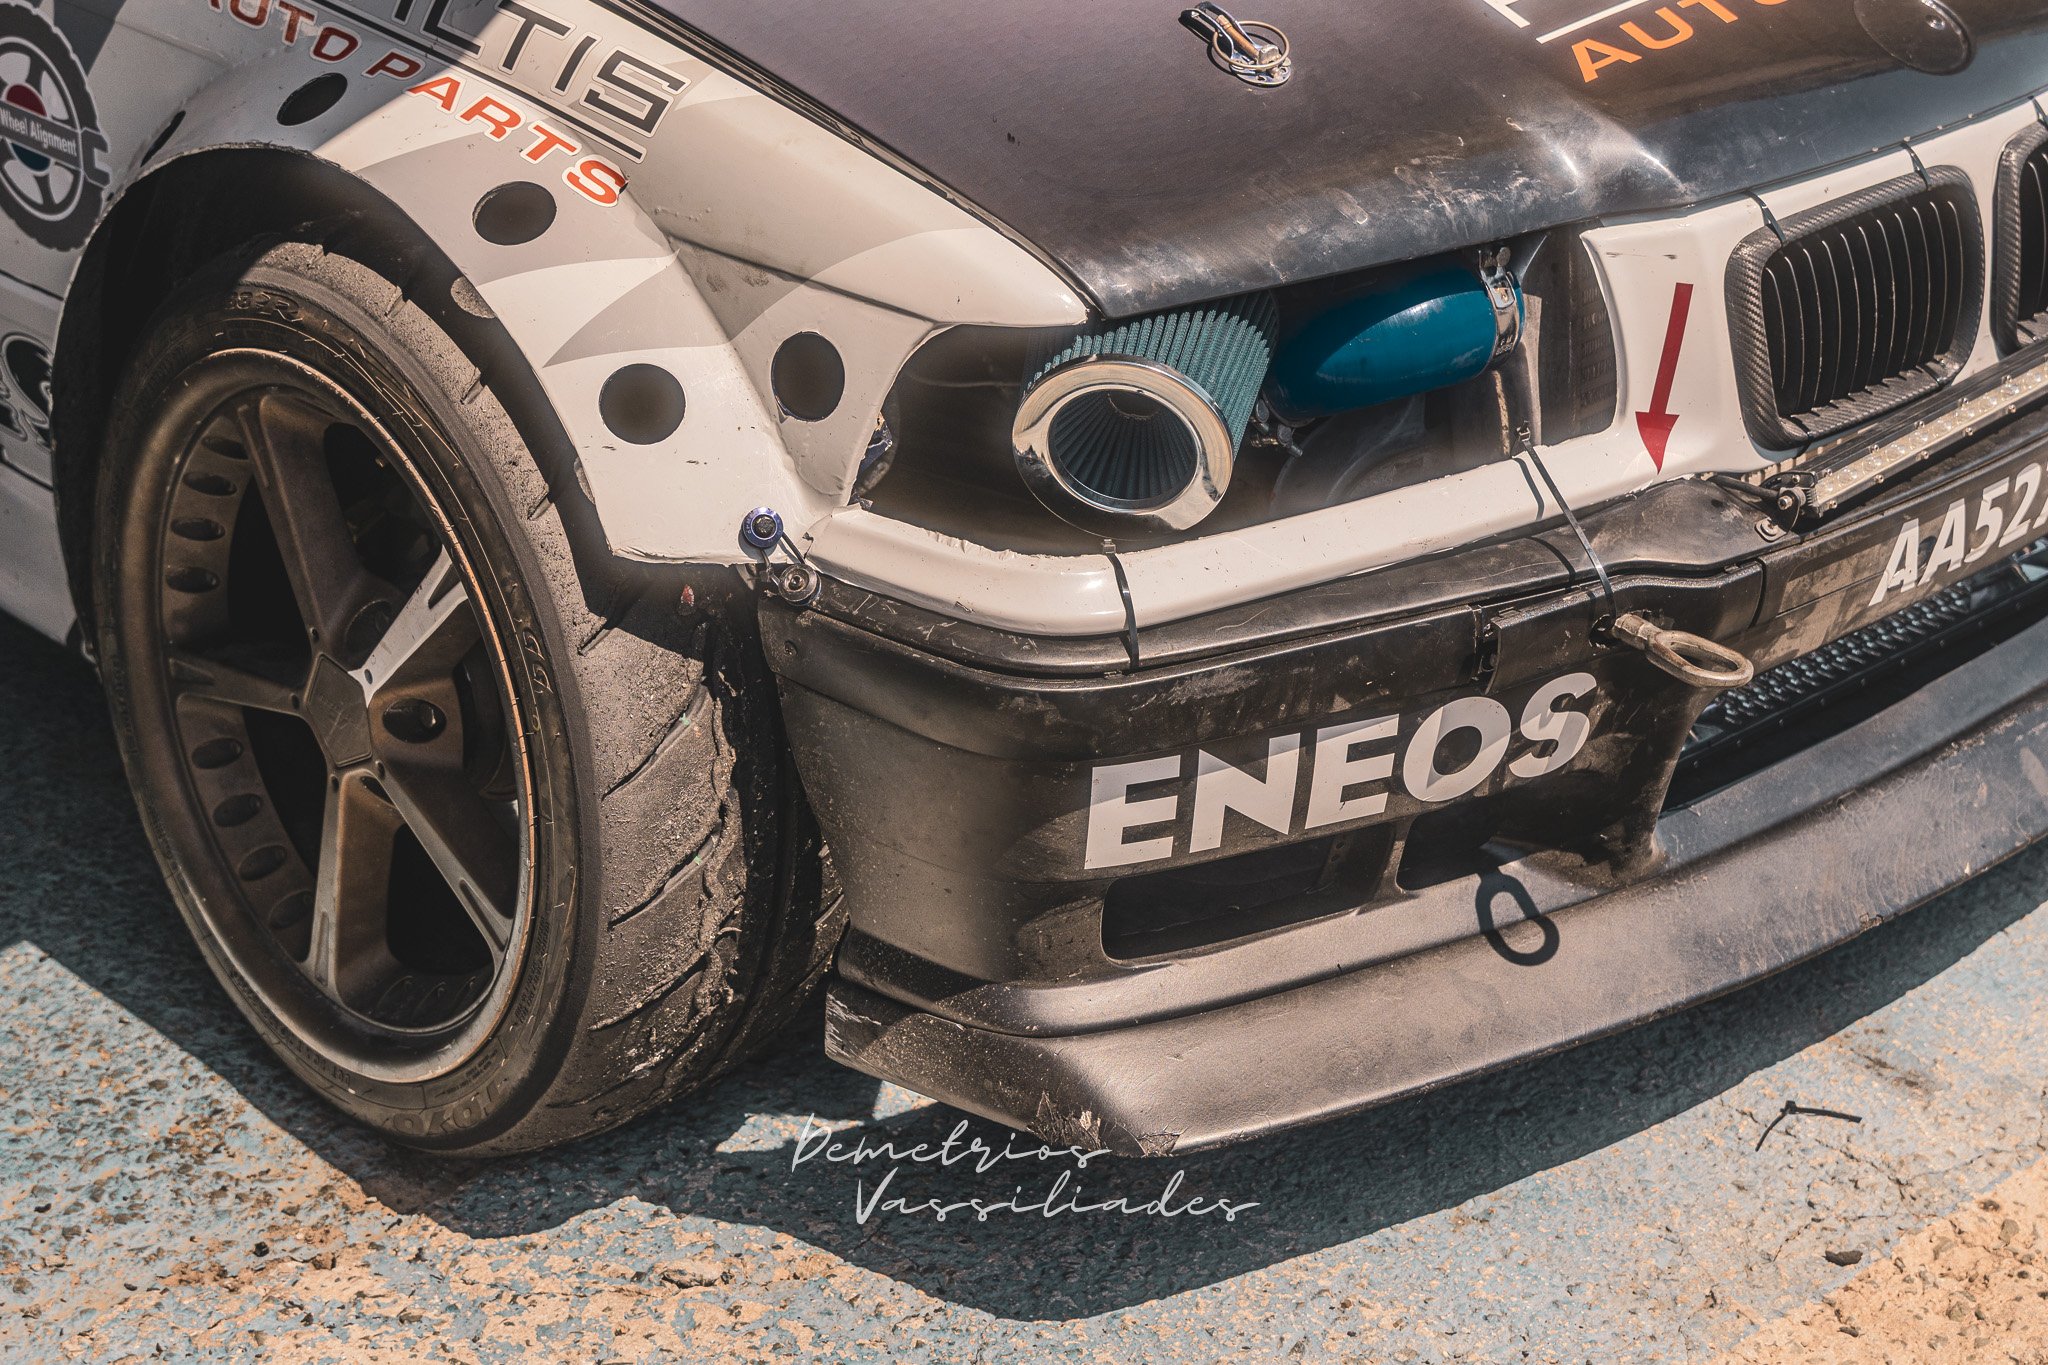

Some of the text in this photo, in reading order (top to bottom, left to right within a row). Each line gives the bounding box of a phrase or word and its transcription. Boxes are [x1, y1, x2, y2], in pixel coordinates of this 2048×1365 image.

[209, 0, 628, 205] UTO PARTS
[1571, 0, 1788, 83] AUT
[30, 121, 77, 157] Alignment
[1868, 461, 2048, 607] AA52
[1084, 672, 1597, 870] ENEOS
